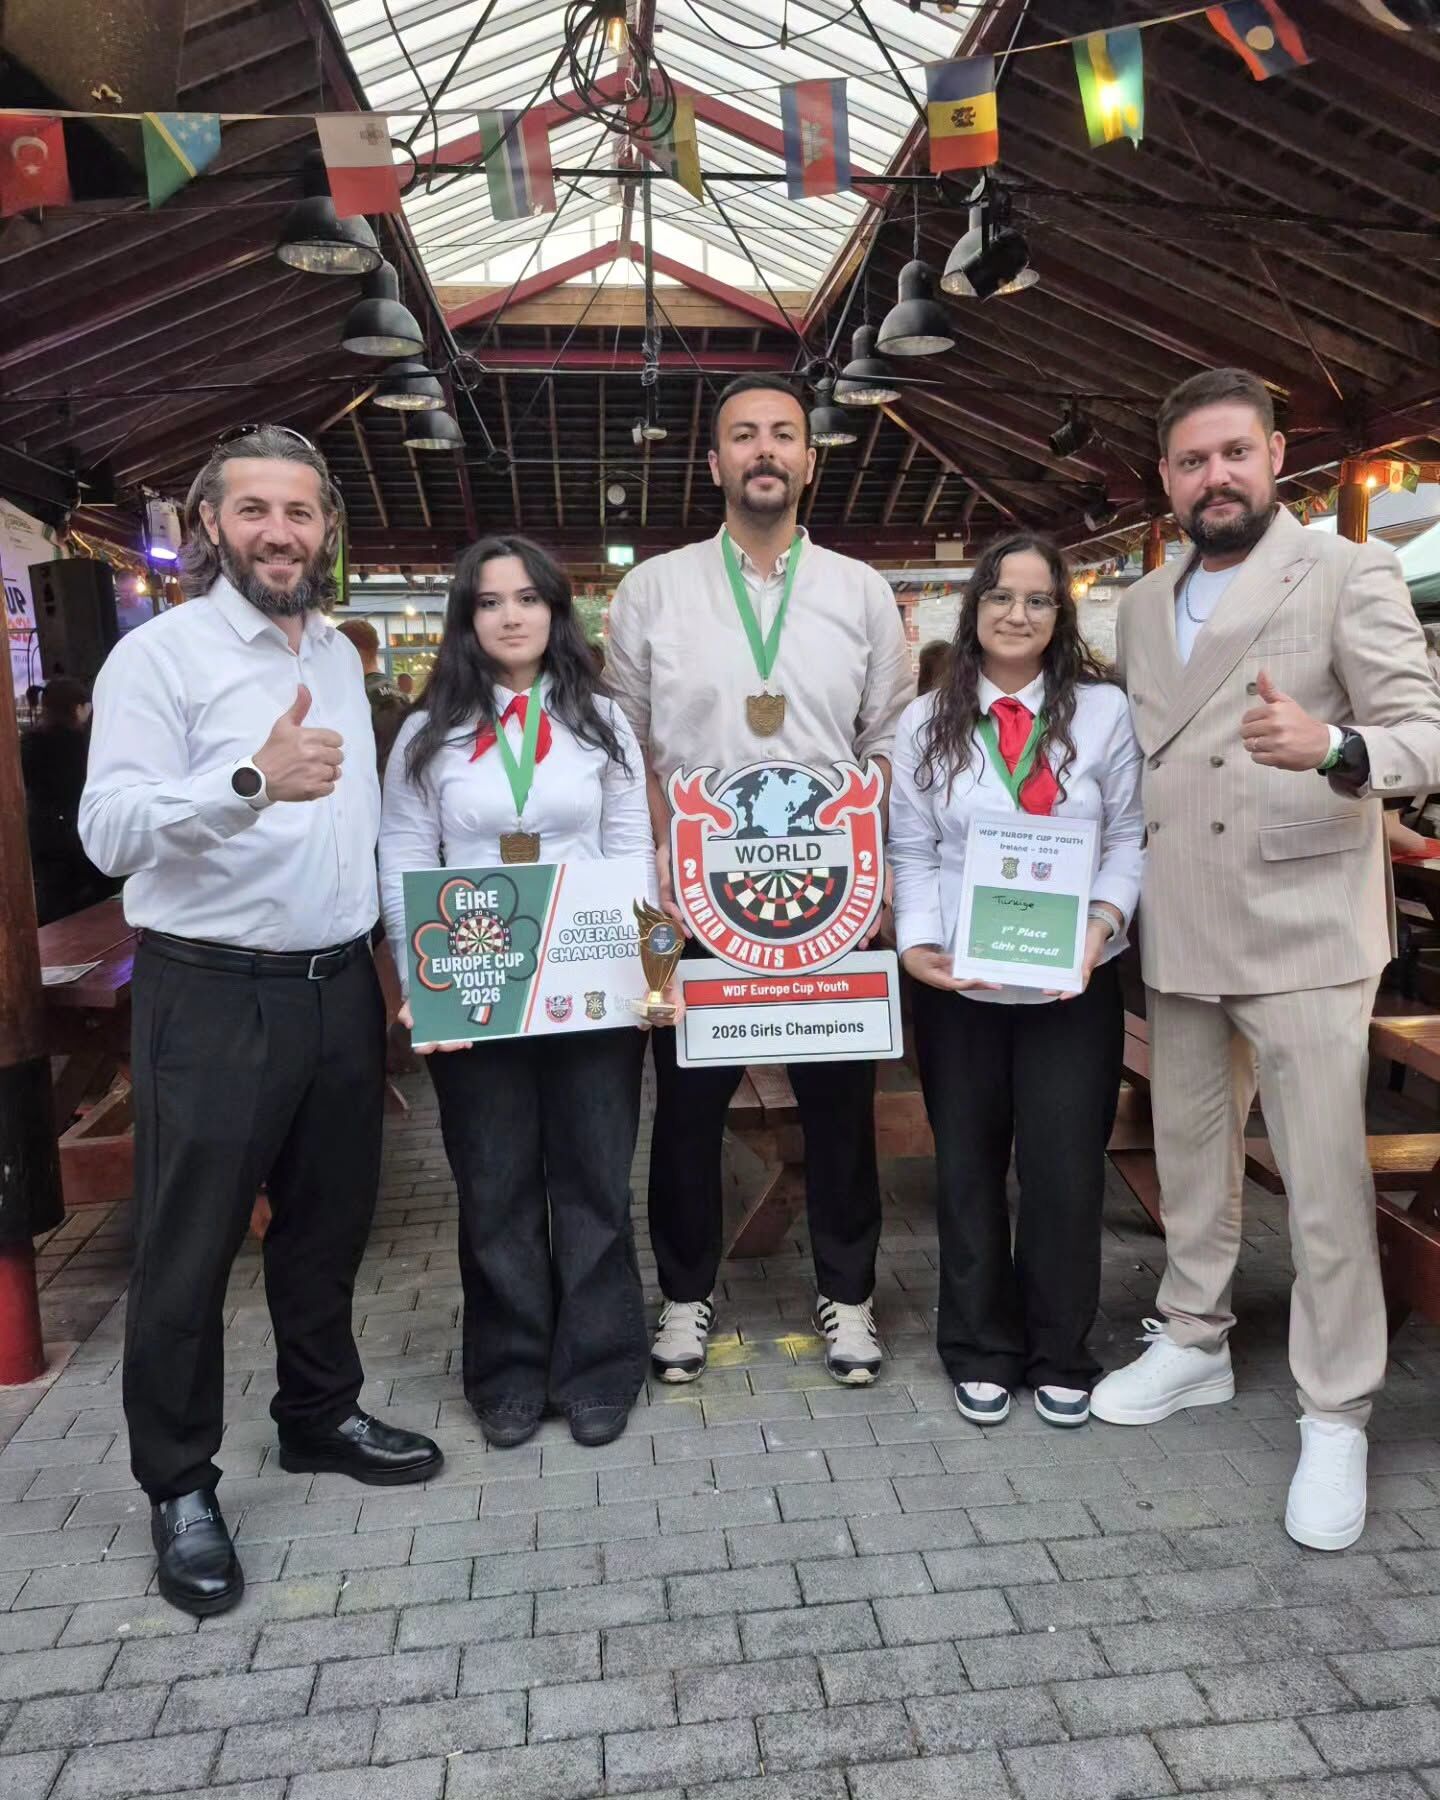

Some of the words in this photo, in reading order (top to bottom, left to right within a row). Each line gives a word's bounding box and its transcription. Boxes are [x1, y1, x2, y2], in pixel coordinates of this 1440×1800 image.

[979, 829, 998, 837] WDF
[1055, 836, 1084, 846] YOUTH
[735, 842, 822, 865] WORLD
[455, 888, 499, 911] ÉIRE
[573, 909, 622, 926] GIRLS
[683, 881, 727, 941] WORLD
[725, 935, 785, 969] DARTS
[797, 874, 876, 965] FEDERATION
[559, 925, 638, 945] OVERALL
[431, 954, 492, 973] EUROPE
[494, 952, 524, 968] CUP
[452, 969, 506, 989] YOUTH
[722, 985, 748, 997] WDF
[750, 984, 790, 996] Europe
[792, 982, 814, 995] Cup
[816, 981, 849, 993] Youth
[461, 987, 501, 1006] 2026
[711, 1024, 747, 1040] 2026
[750, 1023, 783, 1038] Girls
[785, 1020, 865, 1037] Champions
